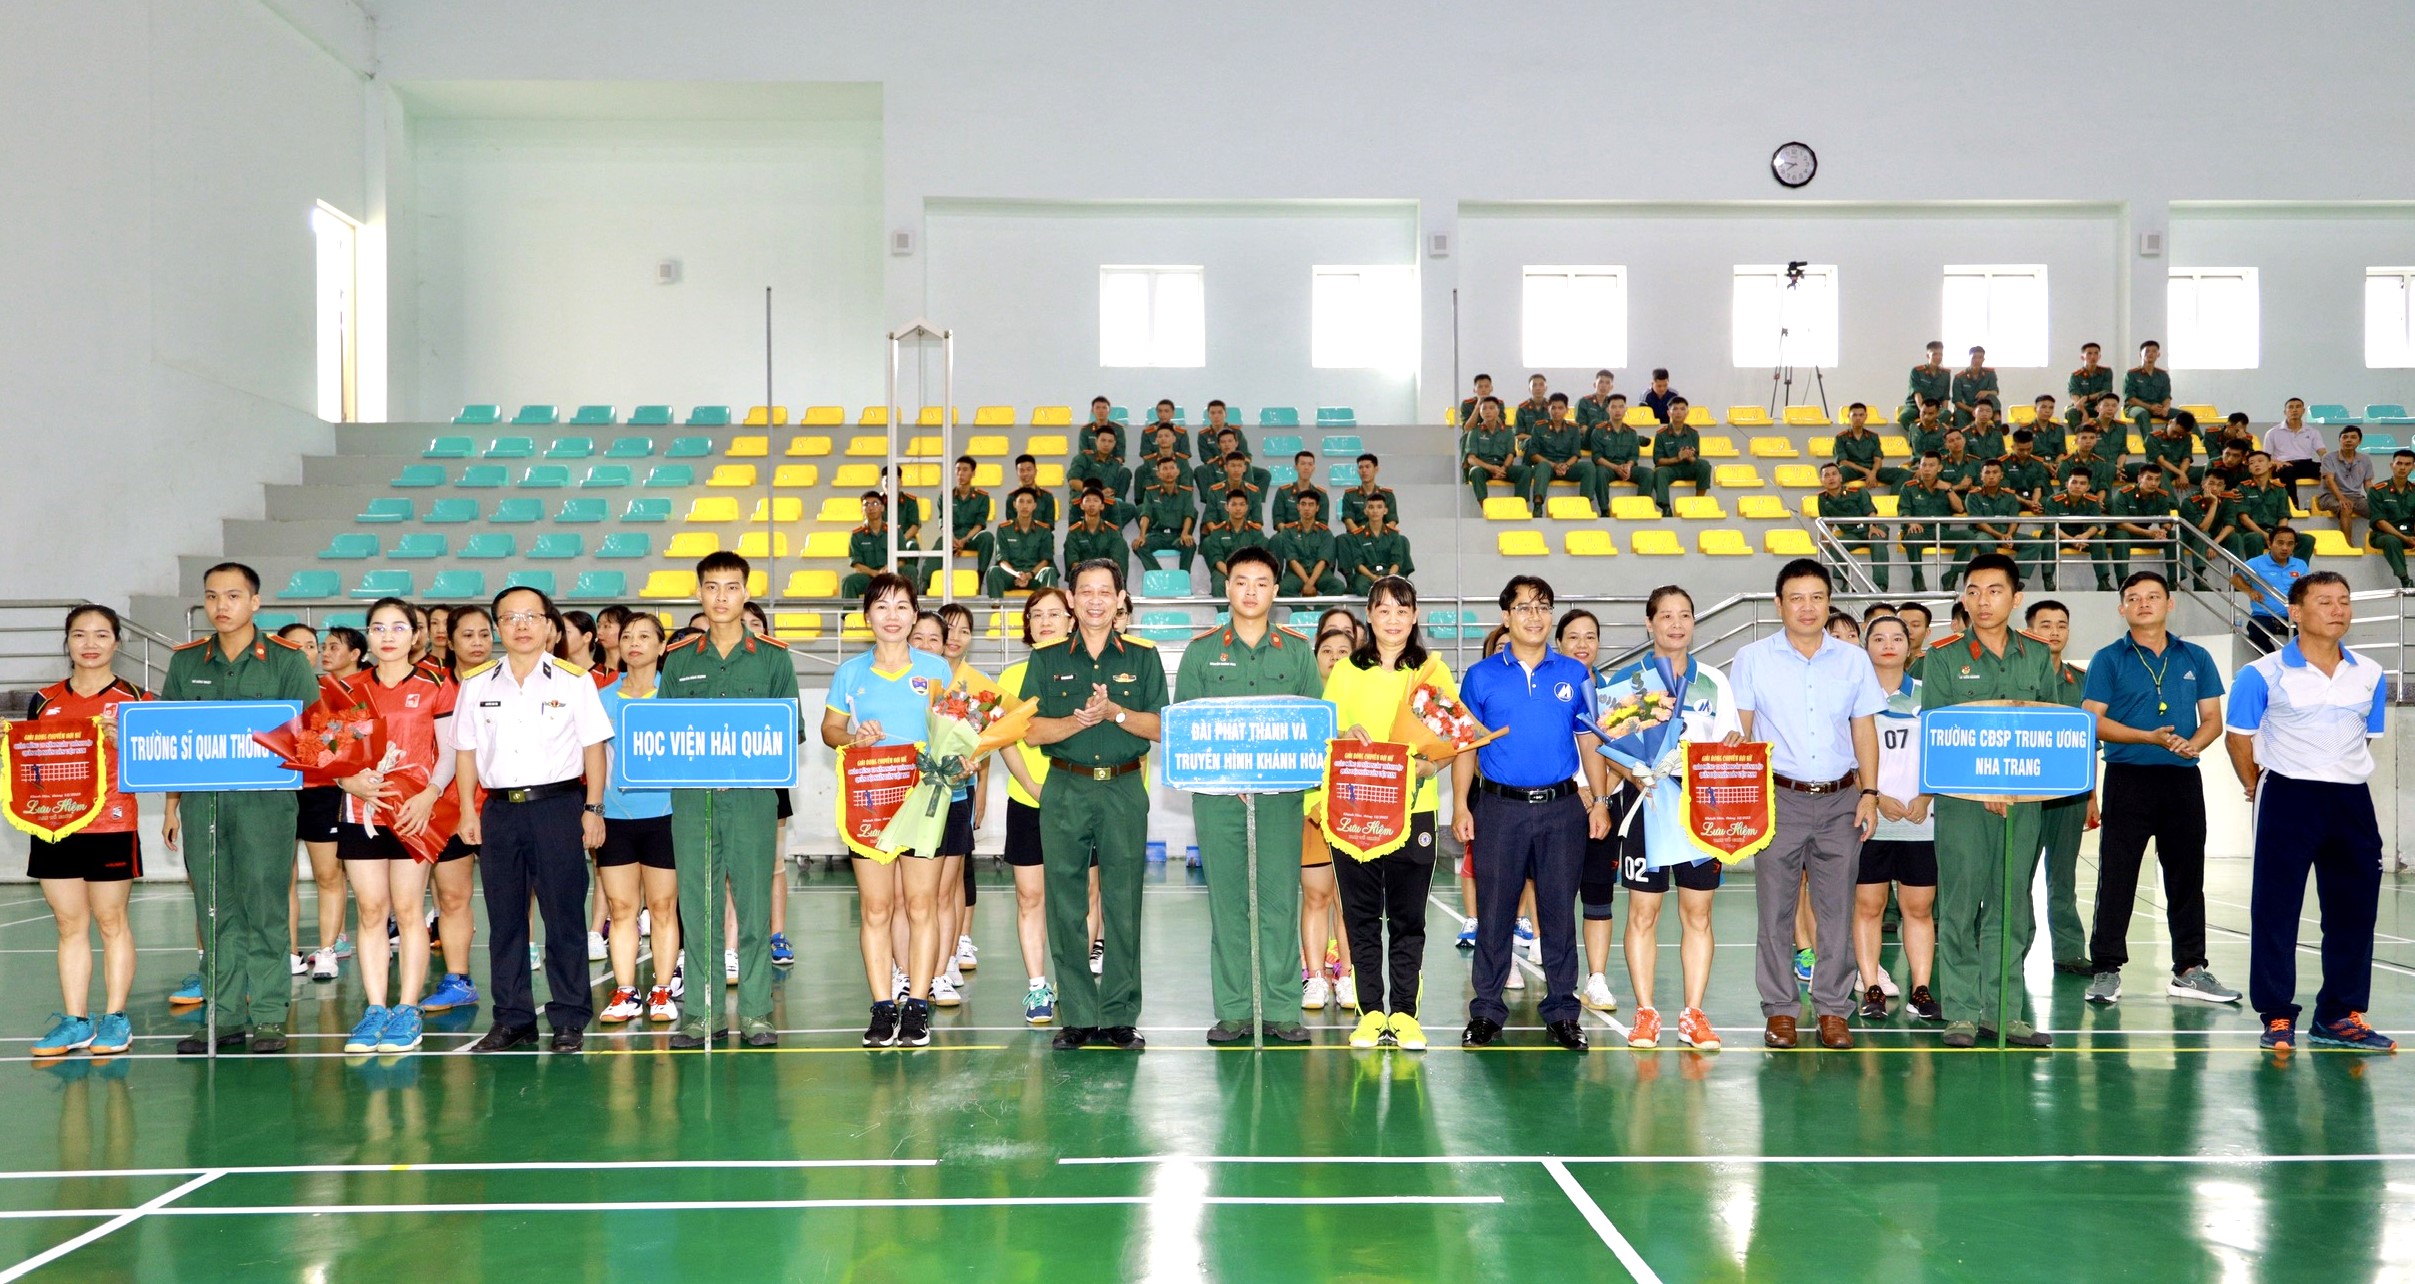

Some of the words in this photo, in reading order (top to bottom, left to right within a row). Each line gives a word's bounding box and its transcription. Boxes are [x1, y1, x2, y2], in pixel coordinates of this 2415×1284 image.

[1191, 718, 1212, 740] ĐÀI
[1249, 722, 1289, 740] THANH
[1291, 717, 1308, 740] VÀ
[1884, 729, 1908, 749] 07
[1930, 724, 1976, 747] TRƯỜNG
[1980, 729, 2012, 748] CĐSP
[2014, 729, 2053, 748] TRUNG
[2056, 728, 2087, 749] ƯƠNG
[130, 729, 178, 761] TRƯỜNG
[181, 729, 193, 760] SĨ
[195, 734, 227, 762] QUAN
[633, 730, 665, 762] HỌC
[669, 724, 706, 762] VIỆN
[710, 722, 736, 756] HẢI
[741, 723, 783, 759] QUÂN
[1174, 746, 1221, 770] TRUYỀN
[1223, 748, 1253, 770] HÌNH
[1256, 748, 1297, 770] KHÁNH
[1300, 747, 1325, 770] HÒA
[1975, 757, 2000, 775] NHA
[2003, 757, 2041, 776] TRANG
[1625, 855, 1649, 882] 02
